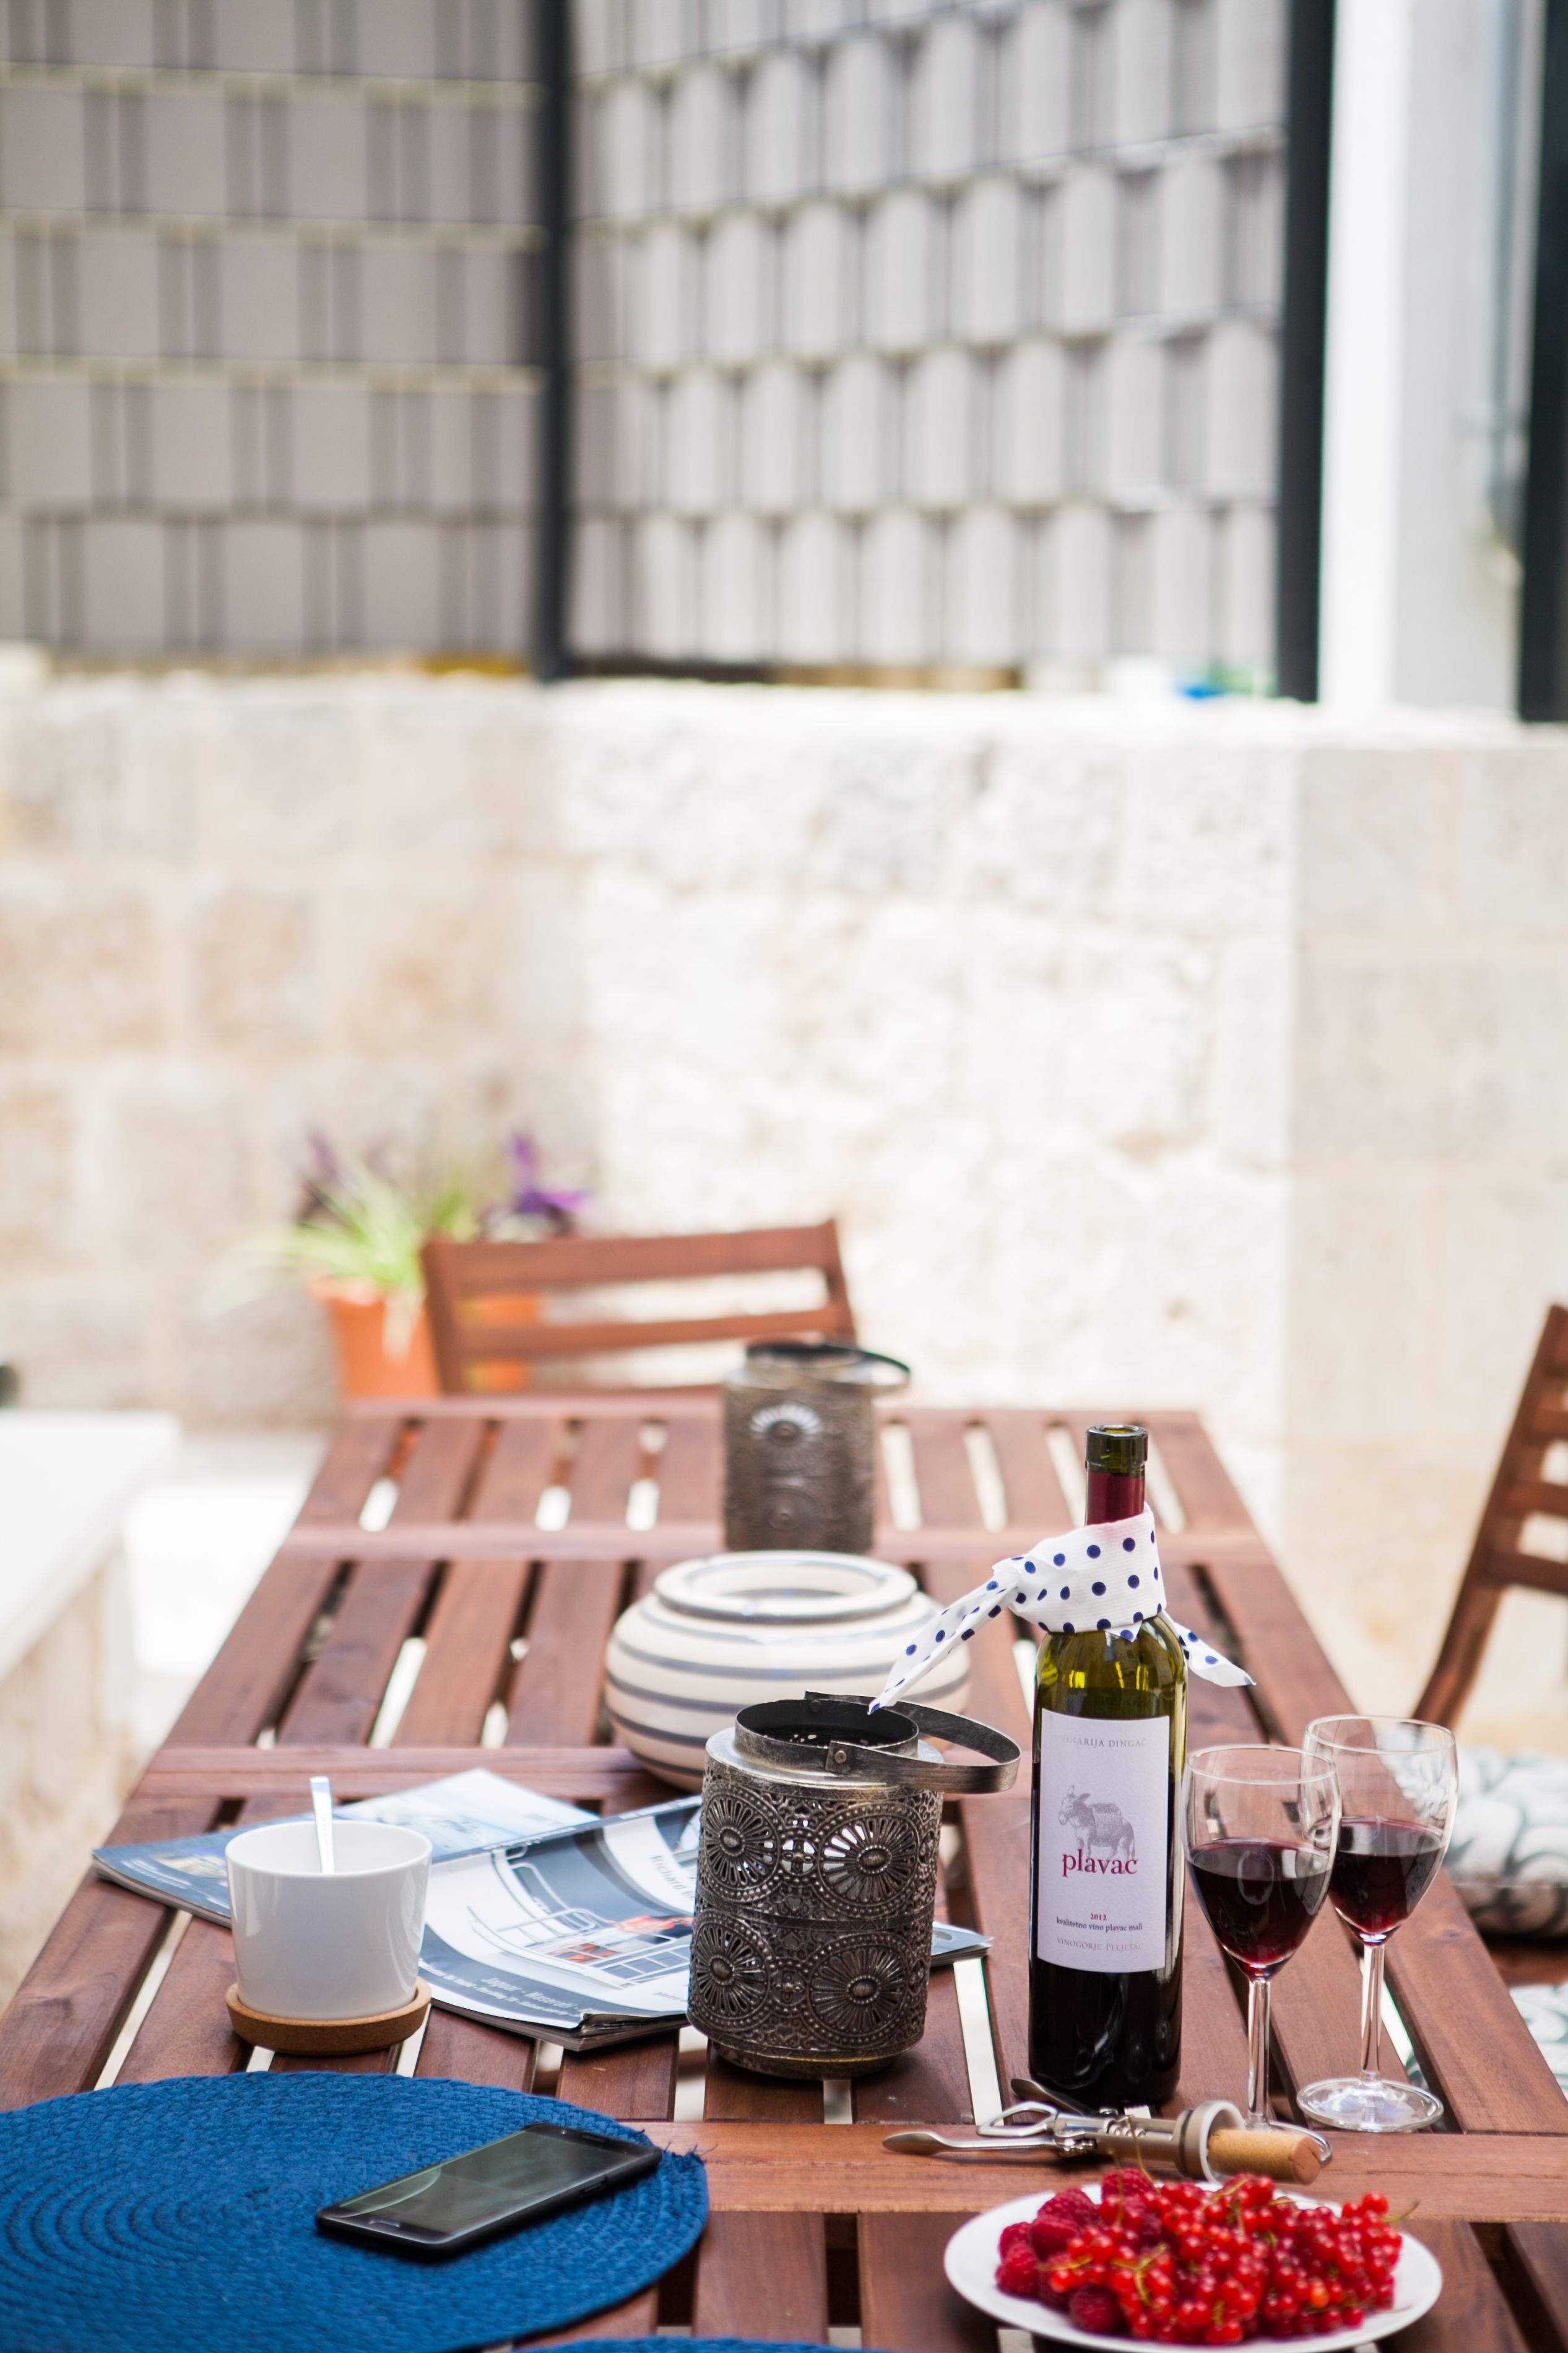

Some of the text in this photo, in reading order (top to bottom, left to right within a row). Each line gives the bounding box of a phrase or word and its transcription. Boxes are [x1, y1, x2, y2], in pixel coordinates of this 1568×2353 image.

[1062, 1848, 1138, 1877] plavac
[1056, 1916, 1088, 1929] kvalitetno
[1105, 1923, 1127, 1933] plavac
[1128, 1923, 1143, 1931] mali
[1056, 1937, 1102, 1952] VINOGORJE
